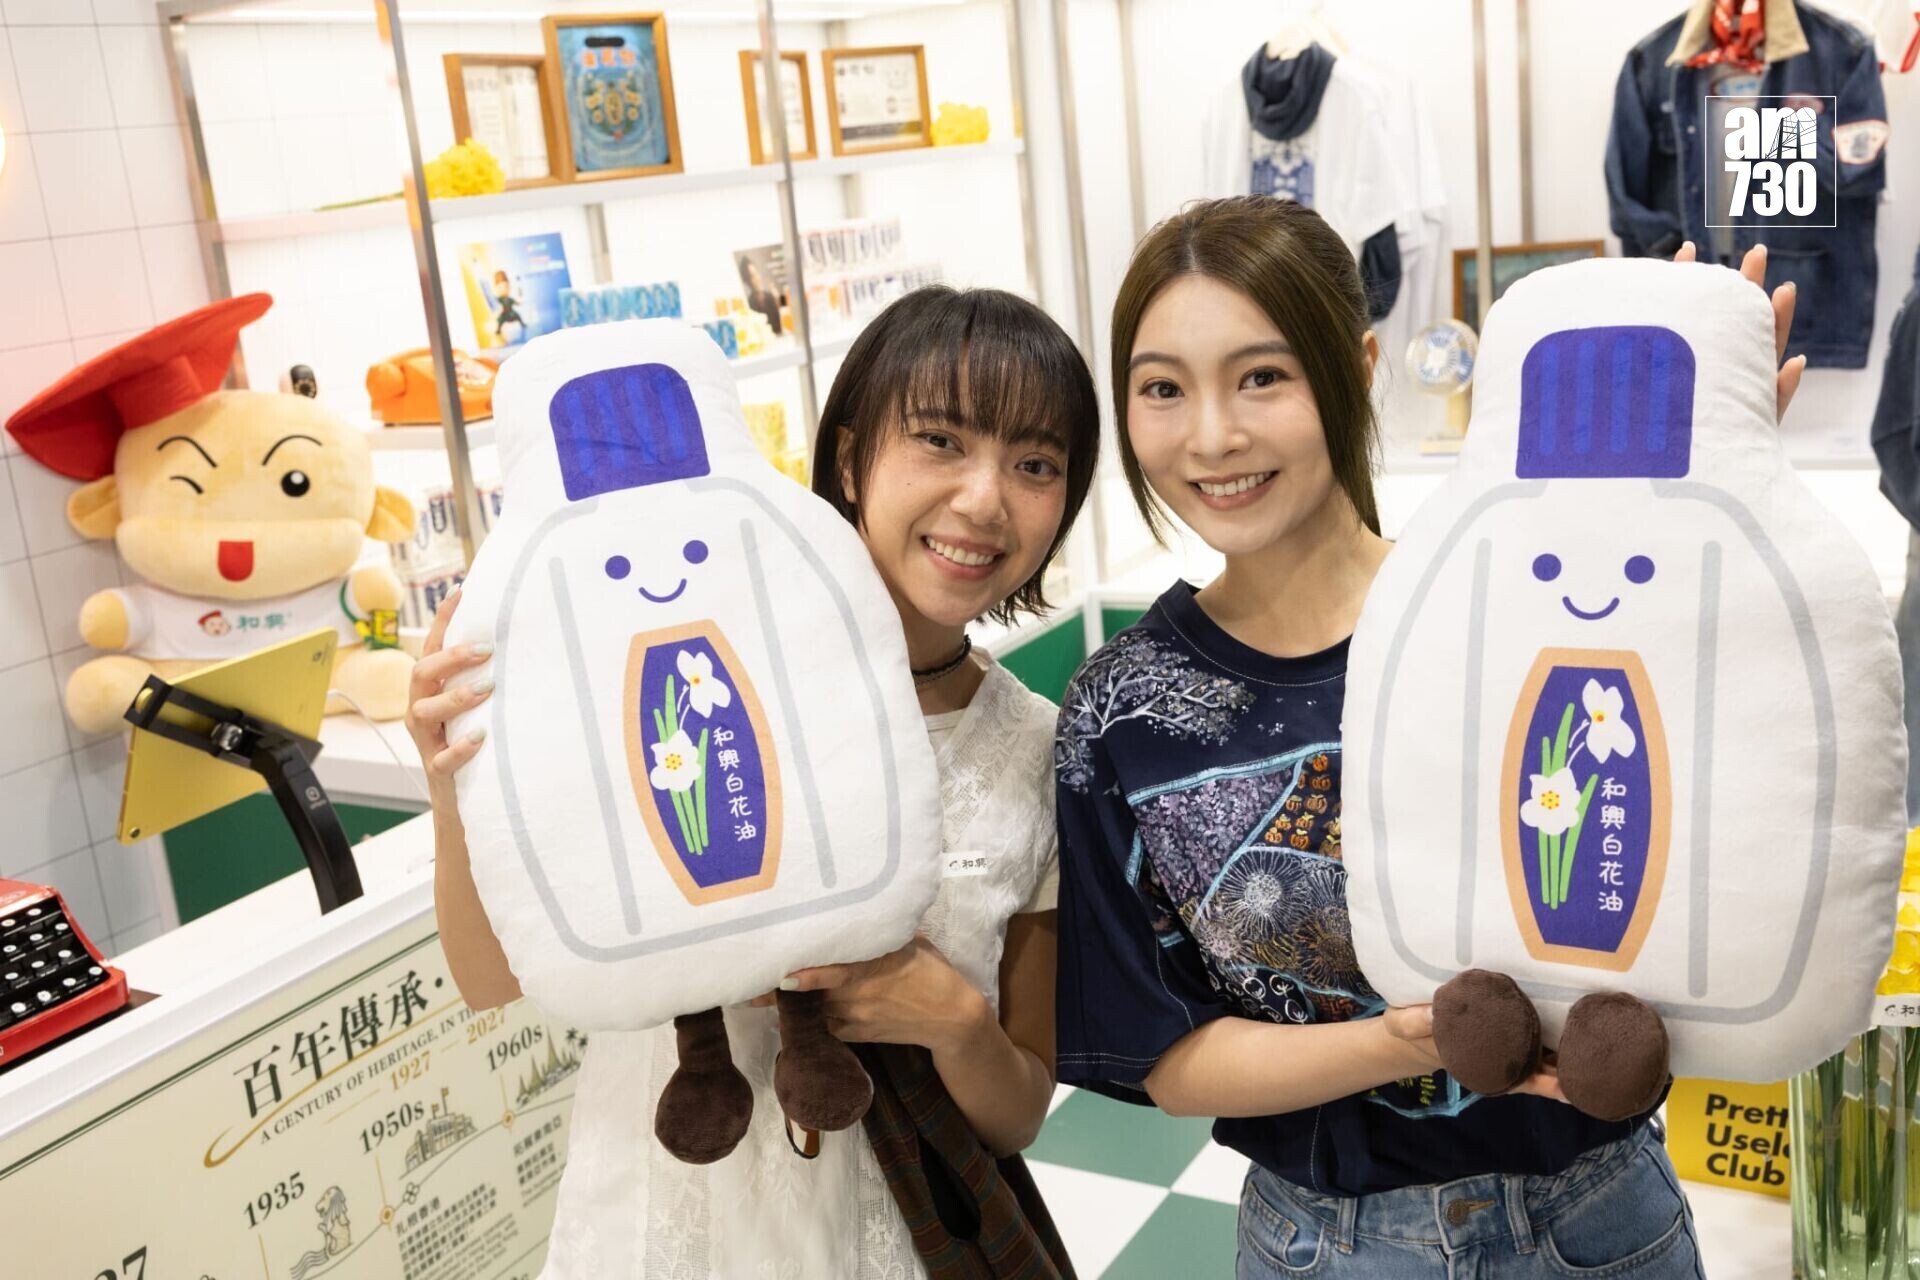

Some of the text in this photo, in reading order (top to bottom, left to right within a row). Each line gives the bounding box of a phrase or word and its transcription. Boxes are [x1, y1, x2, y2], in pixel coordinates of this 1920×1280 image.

[713, 726, 757, 842] 和興白花油
[1598, 777, 1627, 912] 和興白花油
[1901, 1004, 1920, 1017] 和
[388, 1007, 506, 1091] 1927 2027
[486, 1024, 543, 1073] 1960s
[260, 1131, 272, 1144] A
[274, 1083, 343, 1136] CENTURY
[346, 1072, 366, 1091] OF
[440, 1015, 456, 1035] IN
[359, 1100, 424, 1155] 1950s
[1705, 1093, 1789, 1128] Prett
[1706, 1122, 1790, 1158] Usel
[1706, 1152, 1785, 1186] Club
[243, 1171, 305, 1230] 1935
